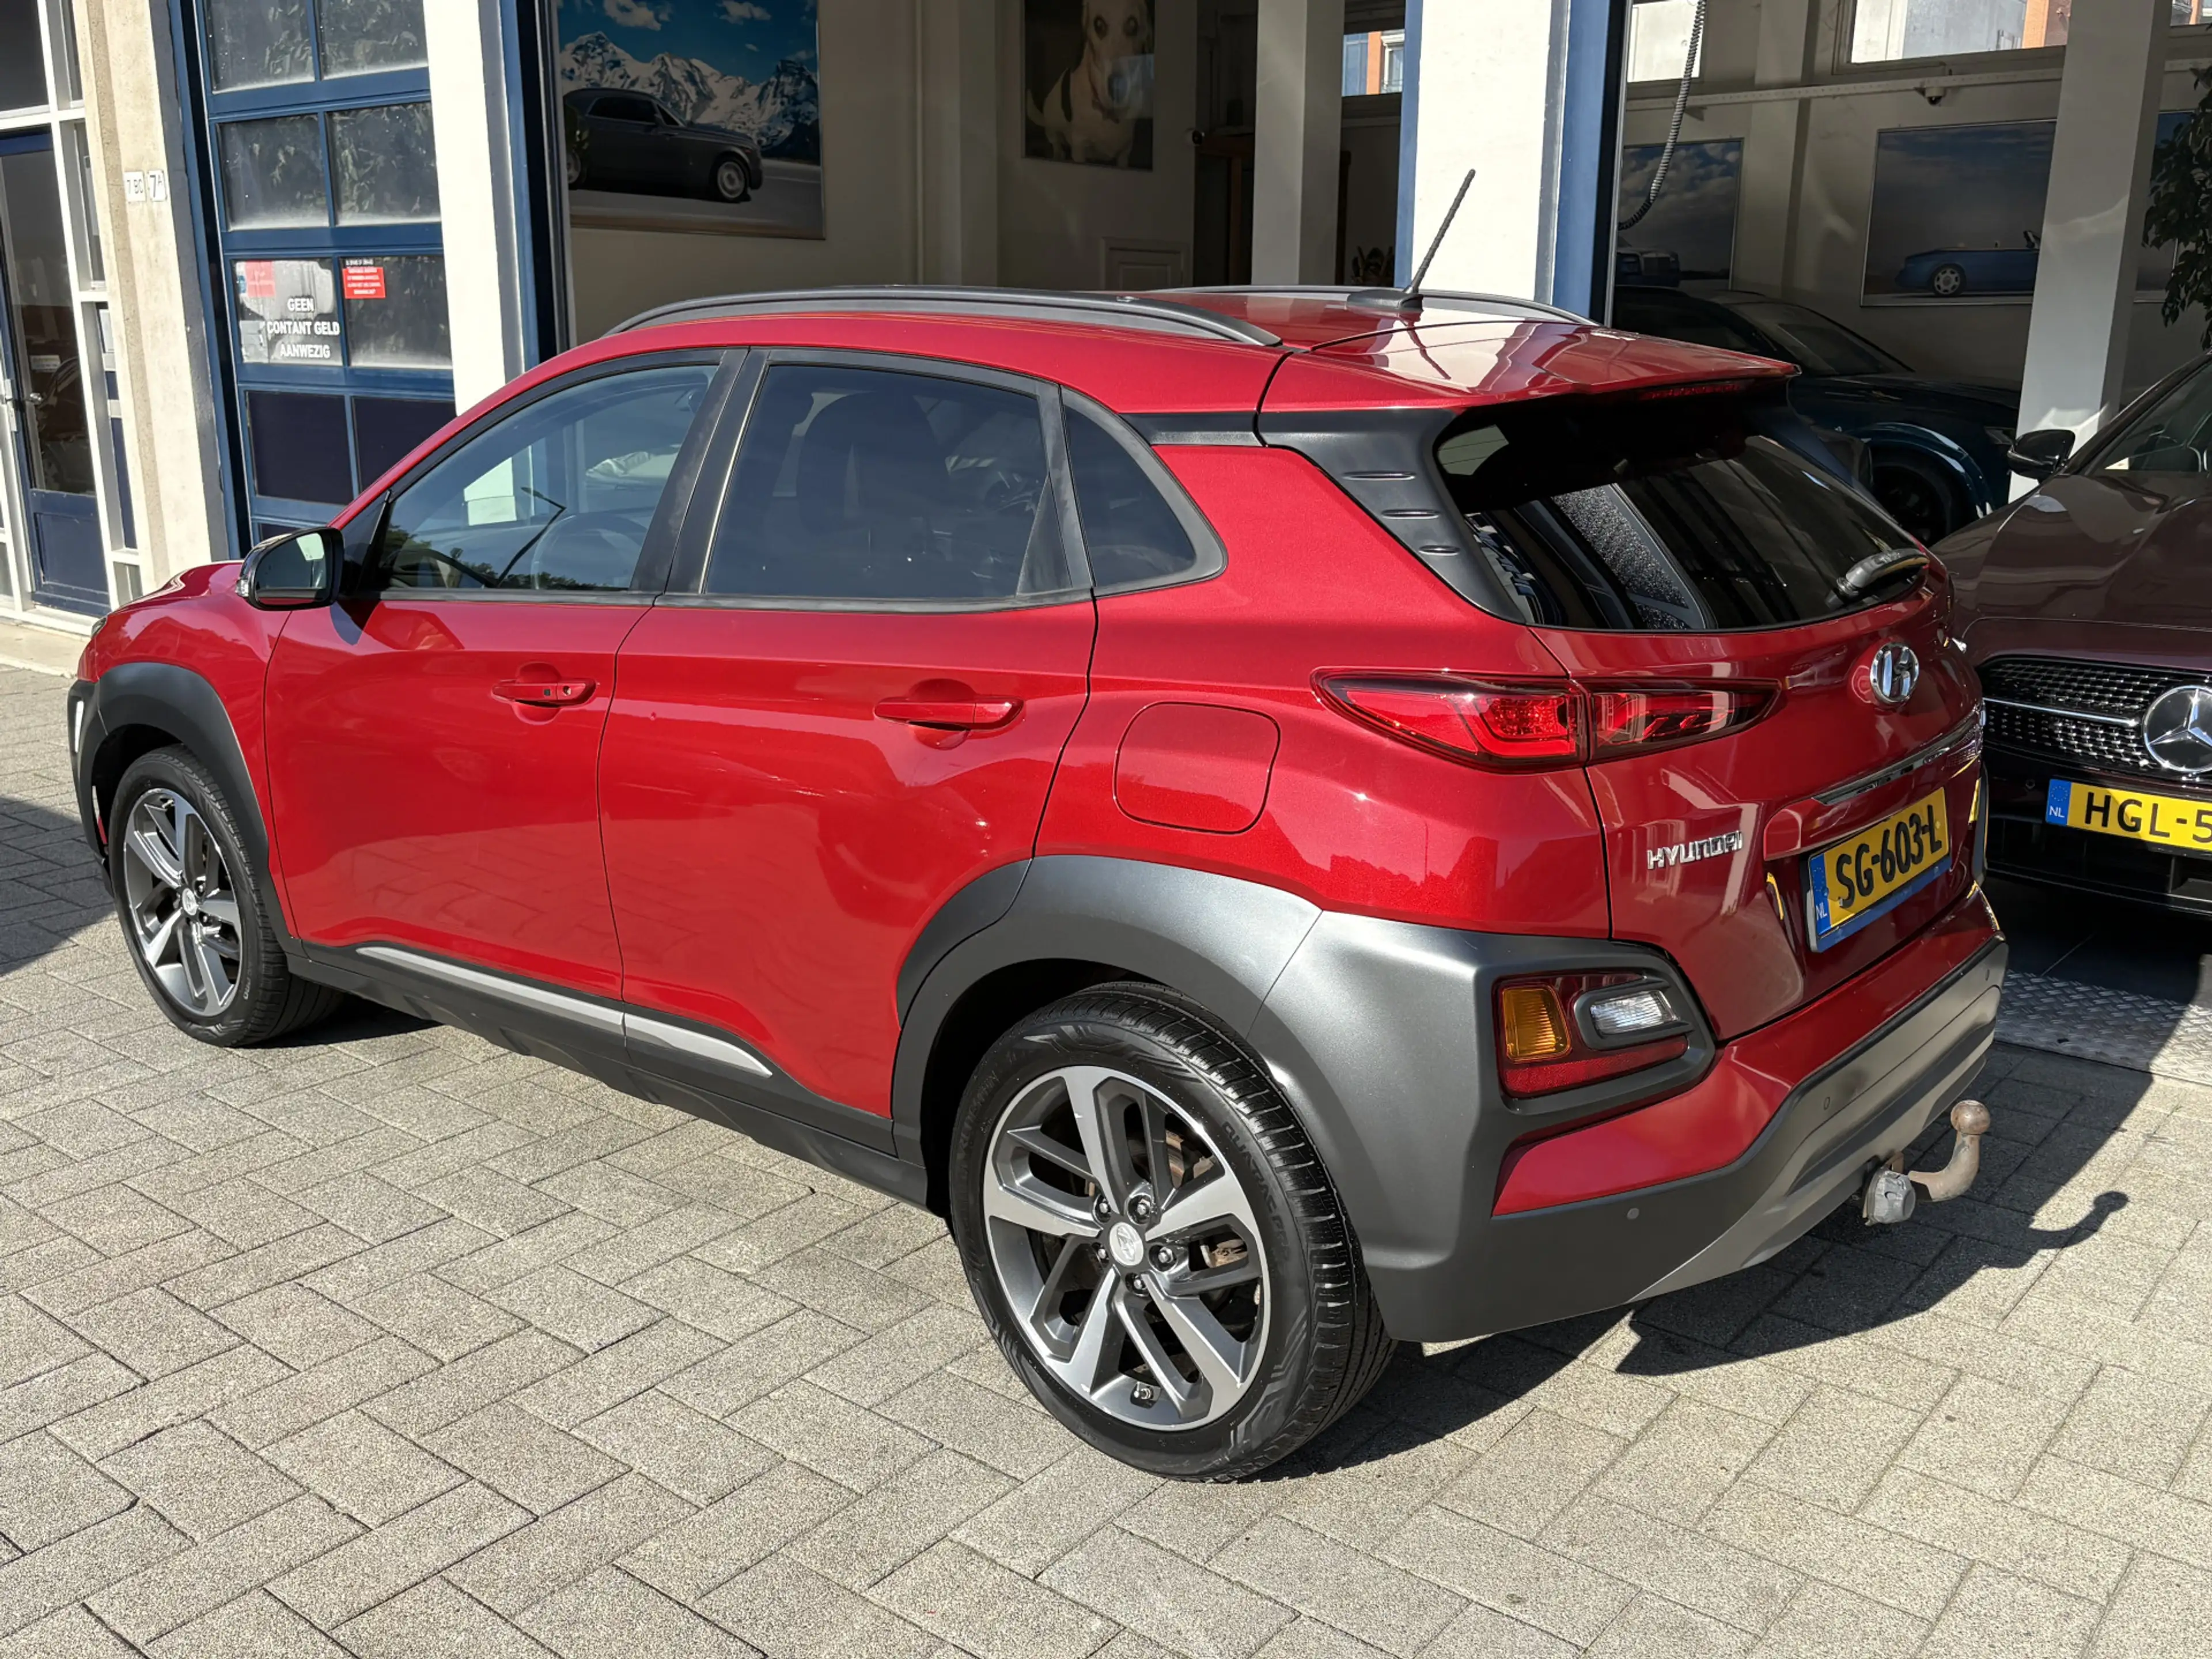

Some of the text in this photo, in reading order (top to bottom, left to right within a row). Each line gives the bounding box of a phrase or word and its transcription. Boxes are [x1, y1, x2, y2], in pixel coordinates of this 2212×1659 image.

[287, 298, 315, 312] GEEN
[267, 321, 340, 335] CONTANT GELD
[280, 344, 331, 358] AANWEZIG
[2049, 805, 2065, 818] NL
[2085, 791, 2212, 843] HGL-5
[1647, 830, 1743, 870] HYUNDAI
[1836, 804, 1942, 909] SG-603-L
[1816, 902, 1827, 921] NL
